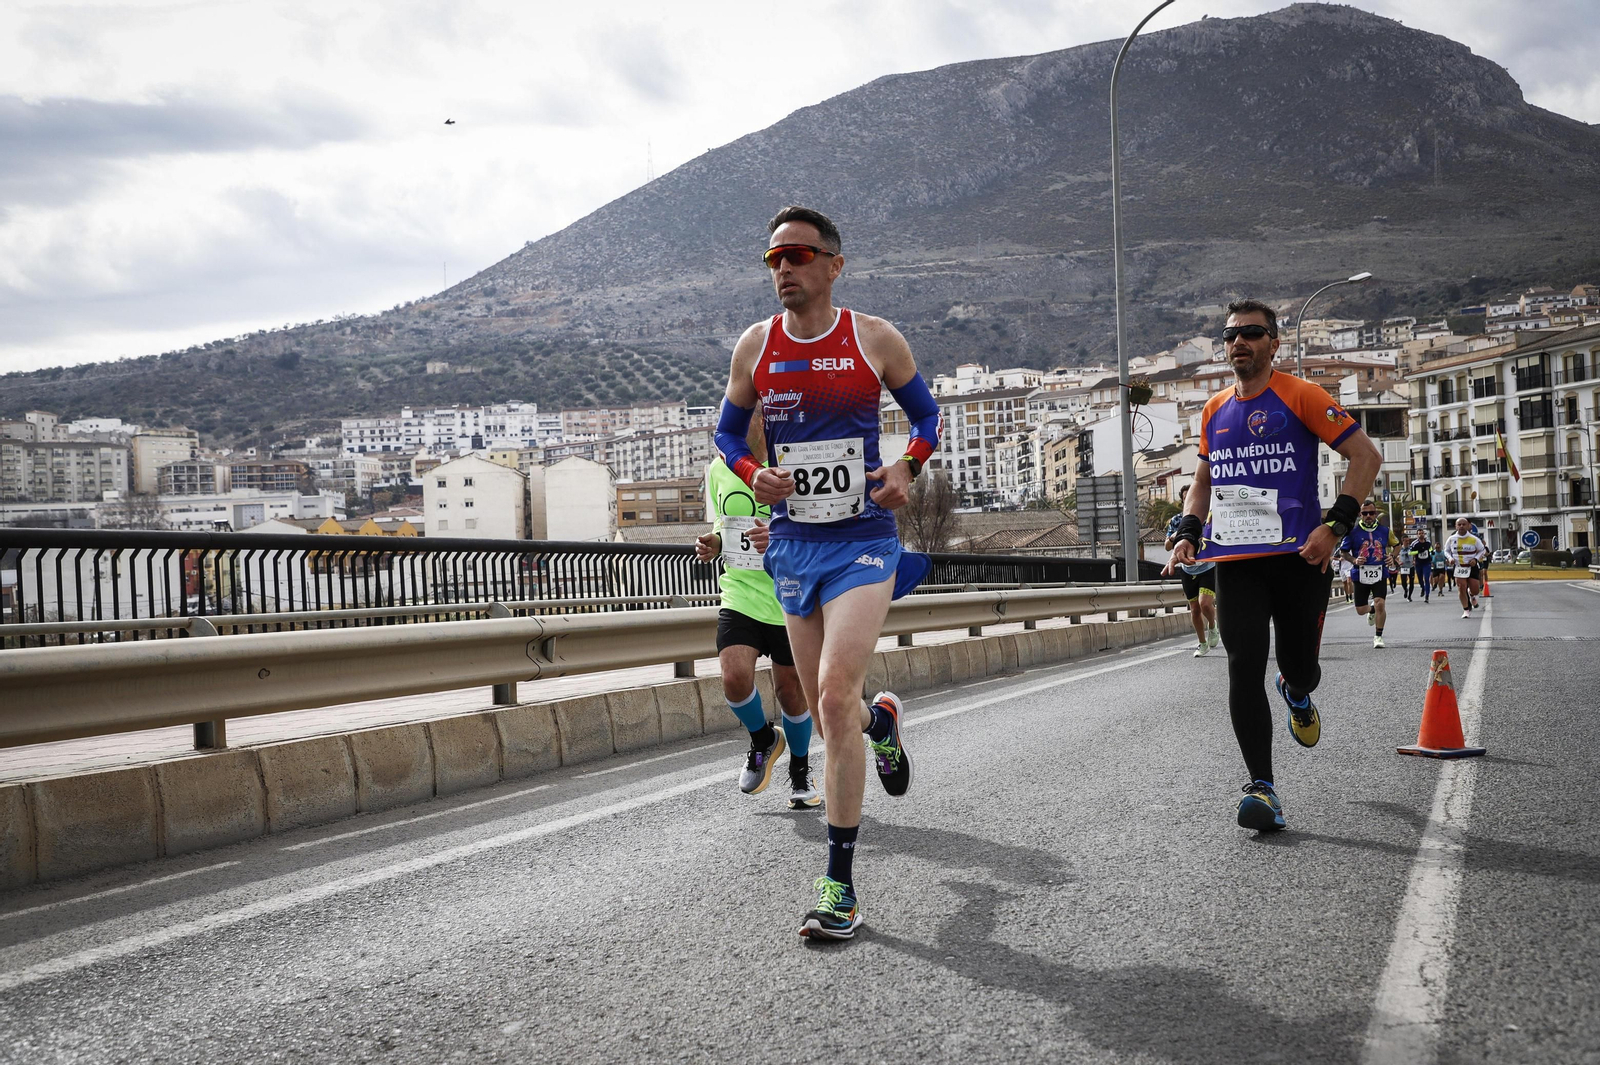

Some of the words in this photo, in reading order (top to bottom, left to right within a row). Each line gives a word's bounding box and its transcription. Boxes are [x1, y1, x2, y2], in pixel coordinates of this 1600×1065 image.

[812, 358, 855, 371] SEUR
[1208, 448, 1233, 462] ONA
[1236, 442, 1295, 459] MÉDULA
[1210, 462, 1247, 479] ONA
[1250, 456, 1297, 475] VIDA
[793, 464, 850, 496] 820
[1220, 510, 1227, 519] YO
[1229, 510, 1247, 518] CORRO
[1248, 509, 1270, 518] CONTRA
[854, 554, 884, 570] SEUR
[1364, 570, 1379, 579] 123
